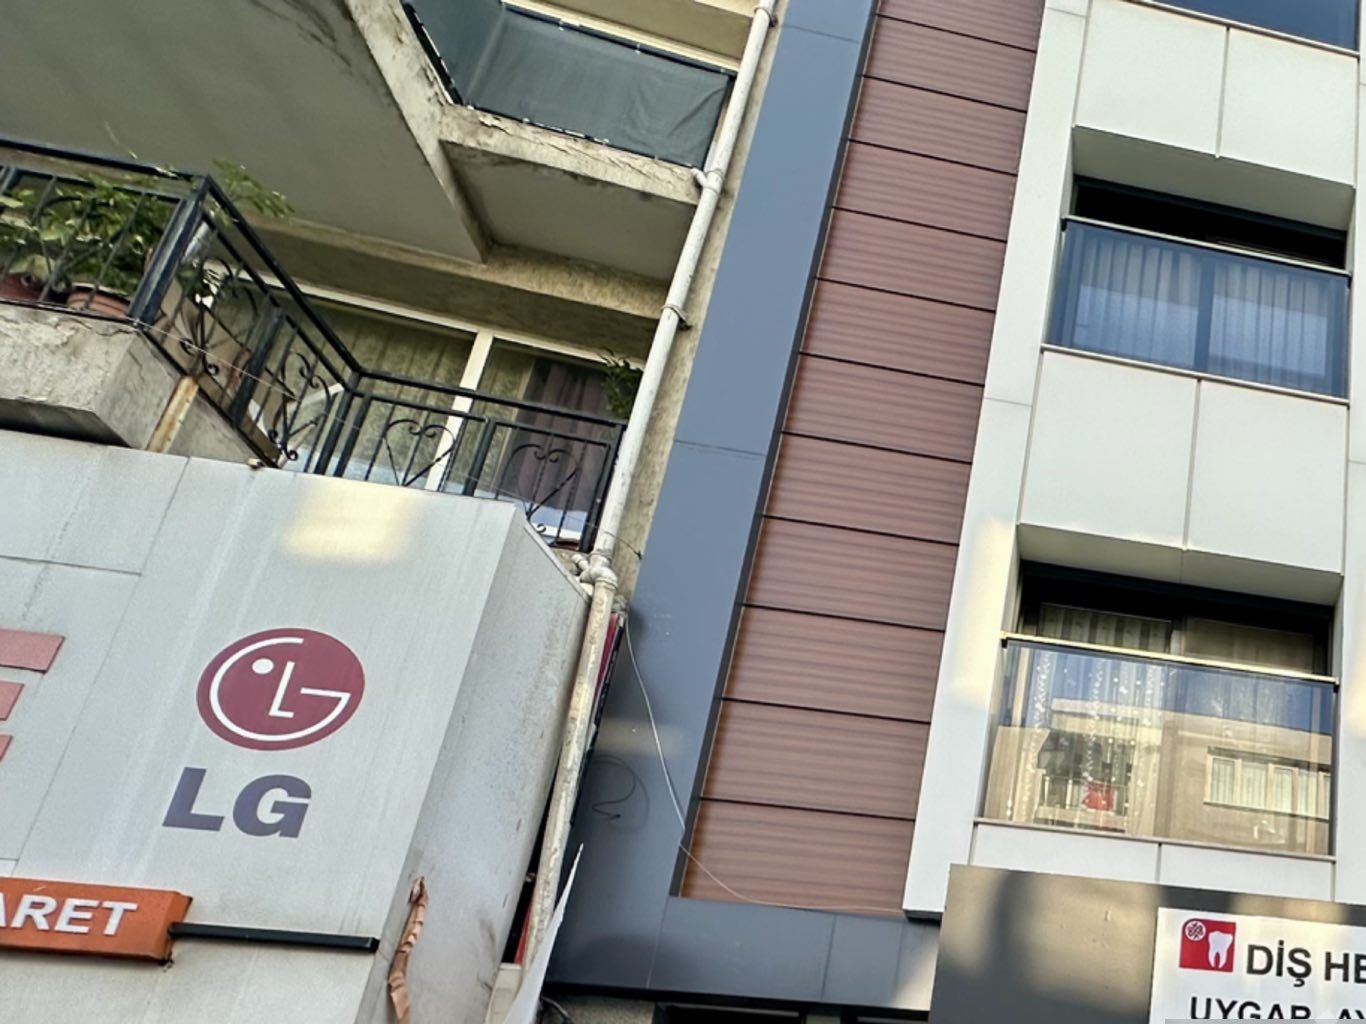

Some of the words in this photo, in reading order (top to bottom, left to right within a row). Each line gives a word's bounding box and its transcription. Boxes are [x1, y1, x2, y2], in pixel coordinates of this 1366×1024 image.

[162, 767, 312, 838] LG
[0, 892, 138, 936] RET
[1246, 940, 1312, 988] DİŞ
